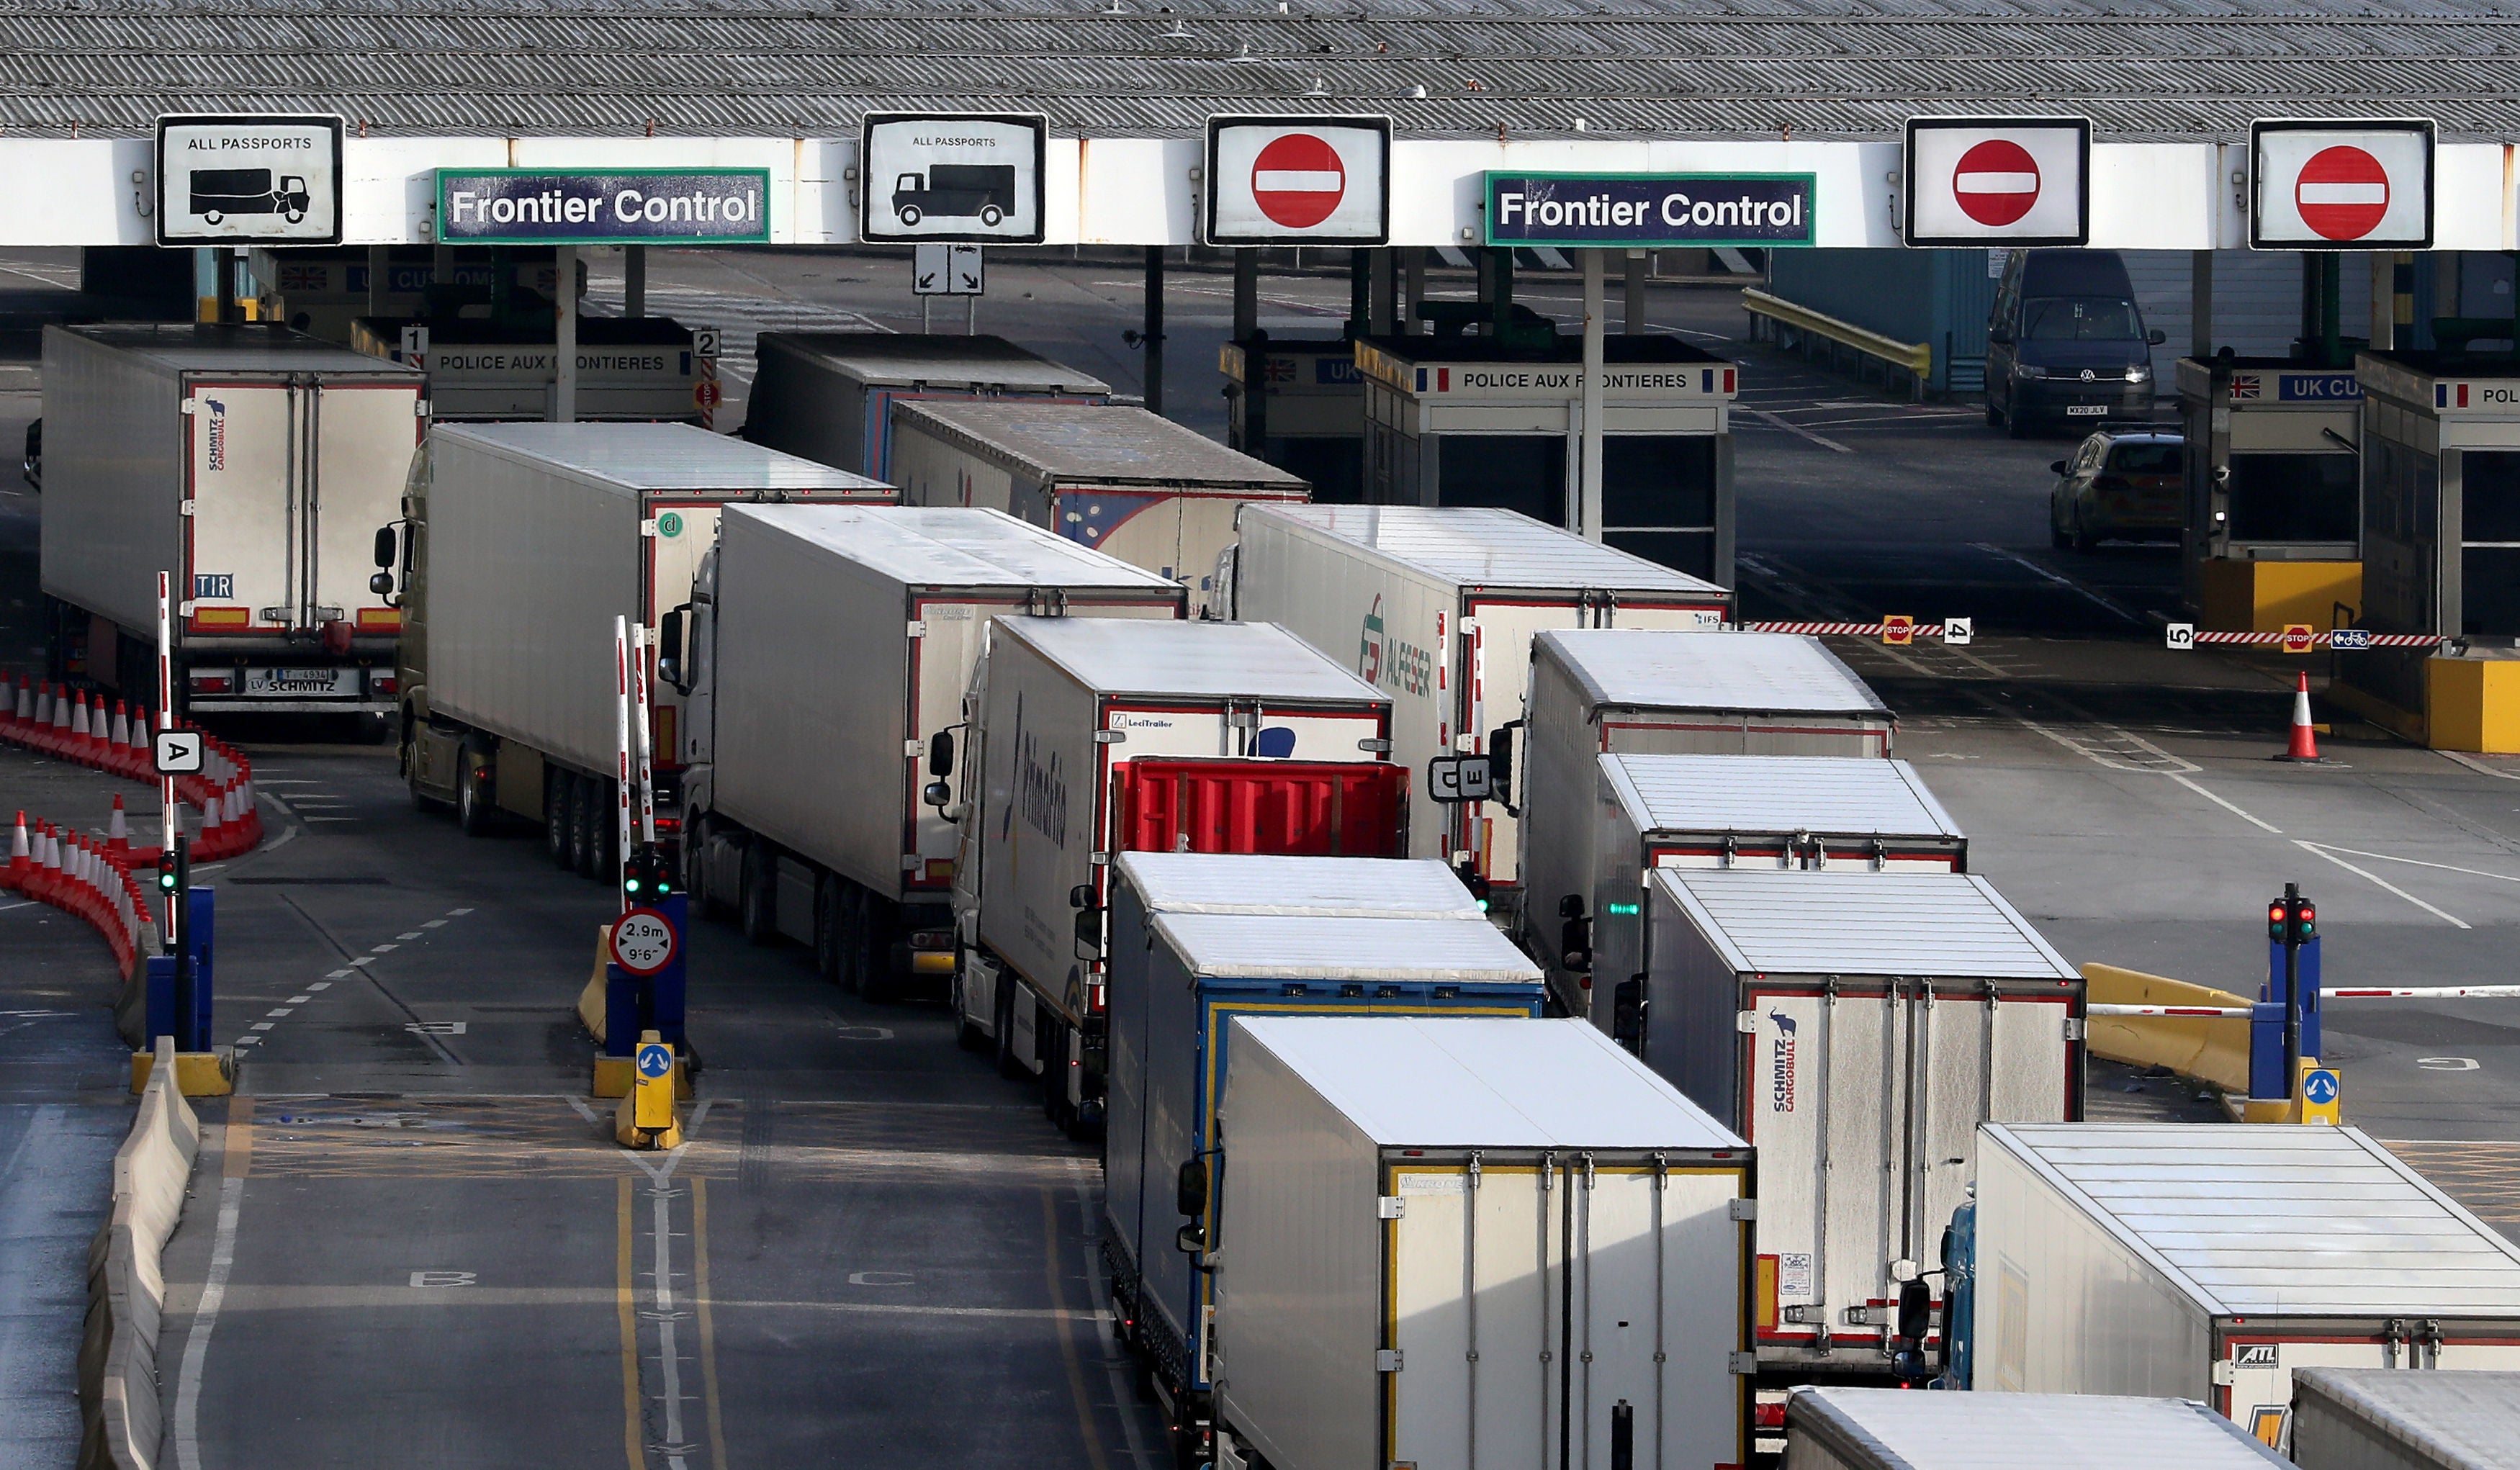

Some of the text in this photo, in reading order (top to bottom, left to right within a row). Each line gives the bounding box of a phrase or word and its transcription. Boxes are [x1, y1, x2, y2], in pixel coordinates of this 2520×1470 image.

[188, 137, 311, 150] ALL PASSPORTS
[912, 137, 996, 147] ALL PASSPORTS
[452, 189, 755, 223] Frontier Control
[1500, 192, 1801, 227] Frontier Control
[409, 330, 419, 351] 1
[699, 333, 714, 354] 2
[441, 356, 505, 370] POLICE
[511, 356, 546, 370] AUX
[1464, 373, 1687, 389] POLICE AUX FONTIERES
[2294, 379, 2324, 397] UK
[209, 418, 217, 471] SCHMITZ
[665, 516, 675, 532] d
[197, 576, 230, 597] TIR
[1948, 623, 1968, 638] 4
[2169, 628, 2190, 644] 5
[2286, 633, 2309, 642] STOP
[1385, 637, 1431, 699] ALFESER
[251, 680, 264, 690] LV
[269, 681, 336, 692] SCHMITZ
[168, 742, 189, 762] A
[1441, 771, 1457, 788] D
[1467, 770, 1482, 785] E
[626, 922, 663, 937] 2.9m
[1773, 1039, 1786, 1112] SCHMITZ
[1786, 1039, 1795, 1112] CARGOBULL
[410, 1271, 477, 1286] B
[847, 1271, 916, 1286] C
[2238, 1346, 2275, 1363] ATL
